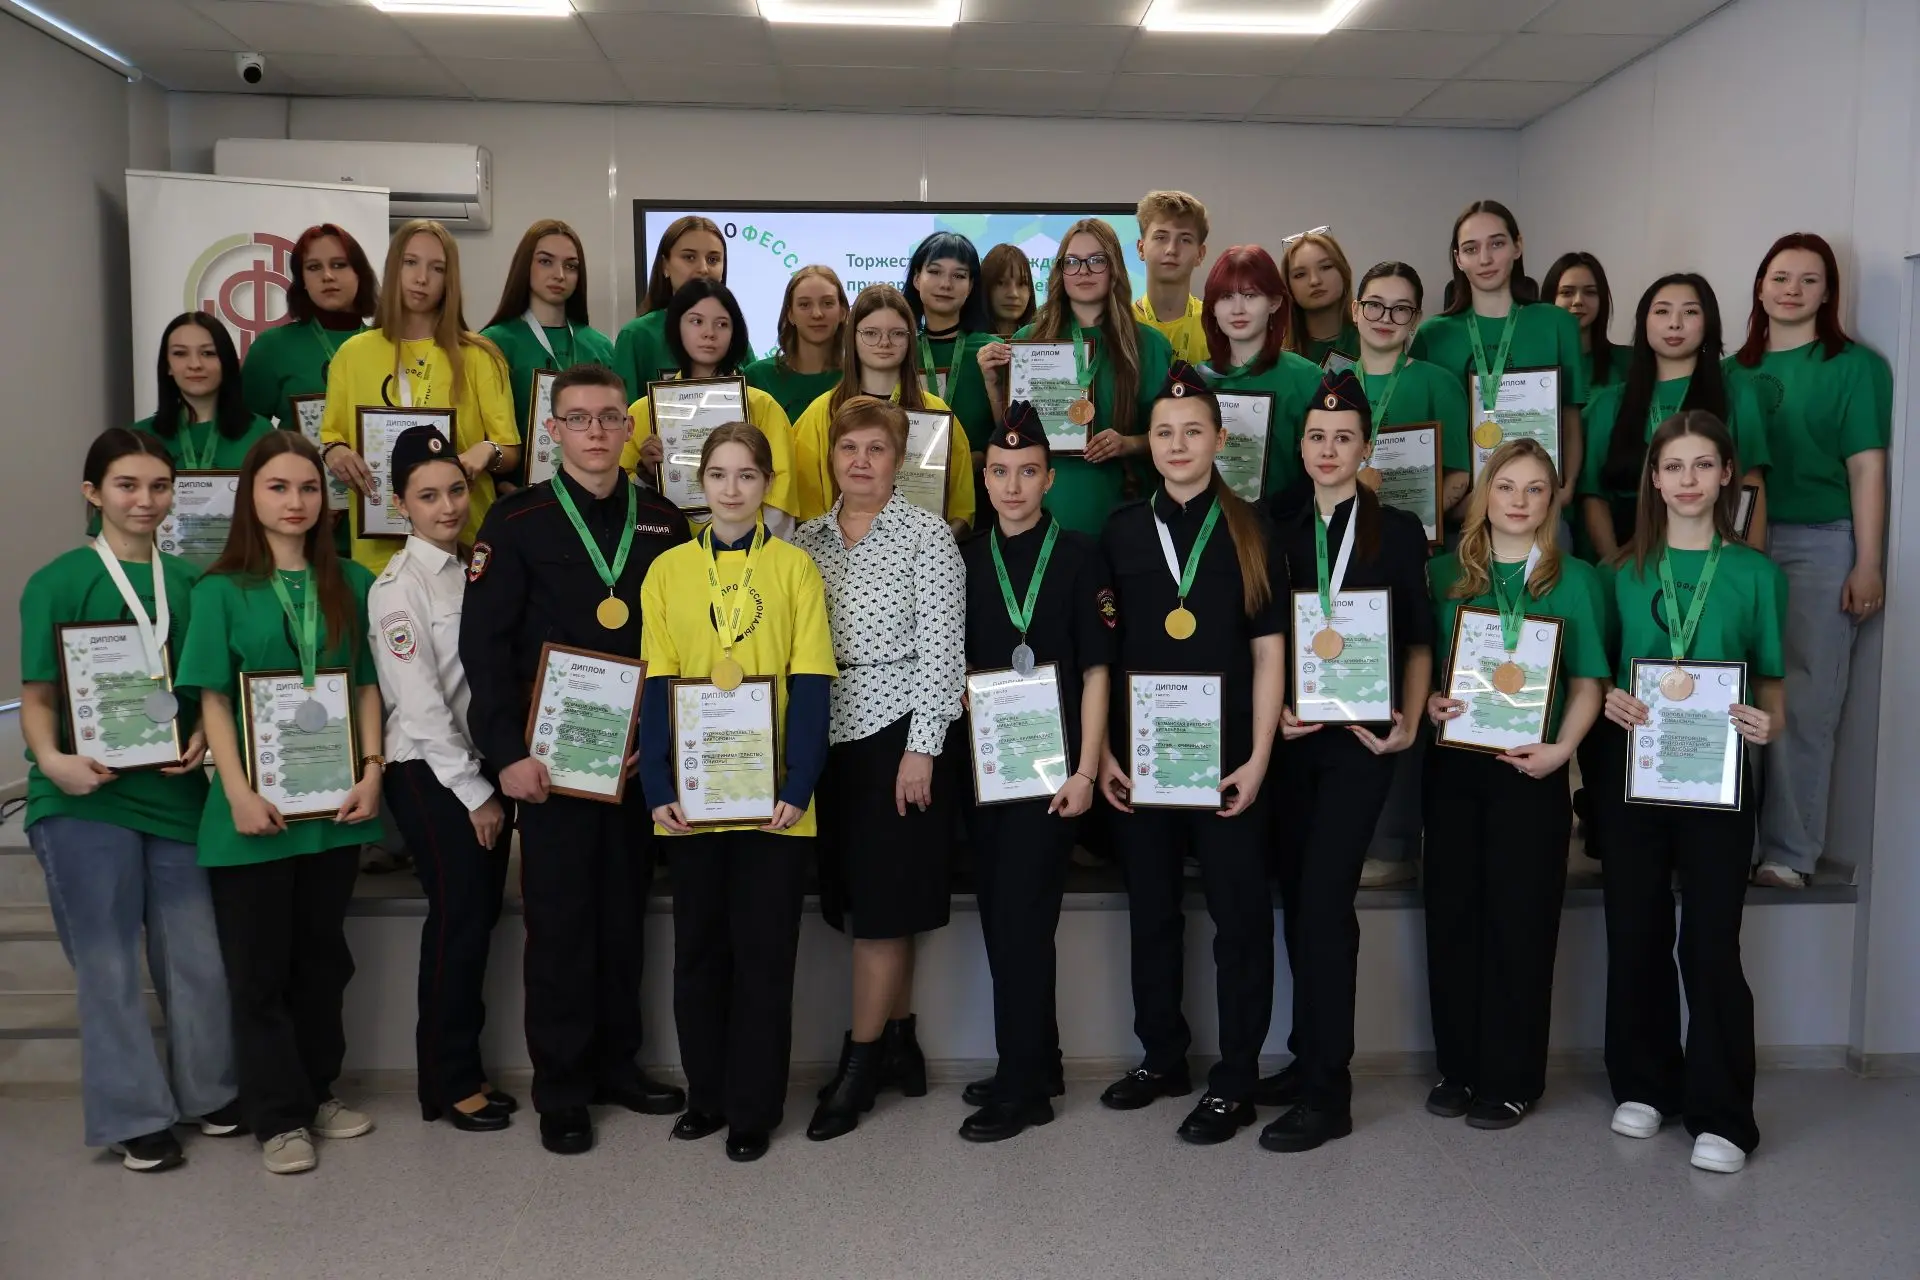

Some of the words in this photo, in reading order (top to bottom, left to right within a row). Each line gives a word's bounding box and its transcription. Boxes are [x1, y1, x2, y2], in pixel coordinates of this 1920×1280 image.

[1499, 379, 1526, 387] ИПЛОМ
[678, 392, 704, 401] ДИПЛО
[1219, 401, 1240, 409] ПЛОМ
[178, 481, 213, 489] ДИПЛОМ
[1331, 600, 1354, 608] ПЛОМ
[721, 583, 764, 638] ПРОССИОНАЛЫ
[1486, 623, 1503, 632] ДИП
[90, 634, 127, 645] ДИПЛОМ
[571, 662, 606, 675] ДИПЛОМ
[276, 682, 304, 691] ДИПЛО
[1155, 683, 1188, 692] ДИПЛОМ
[701, 691, 736, 700] ДИПЛОМ
